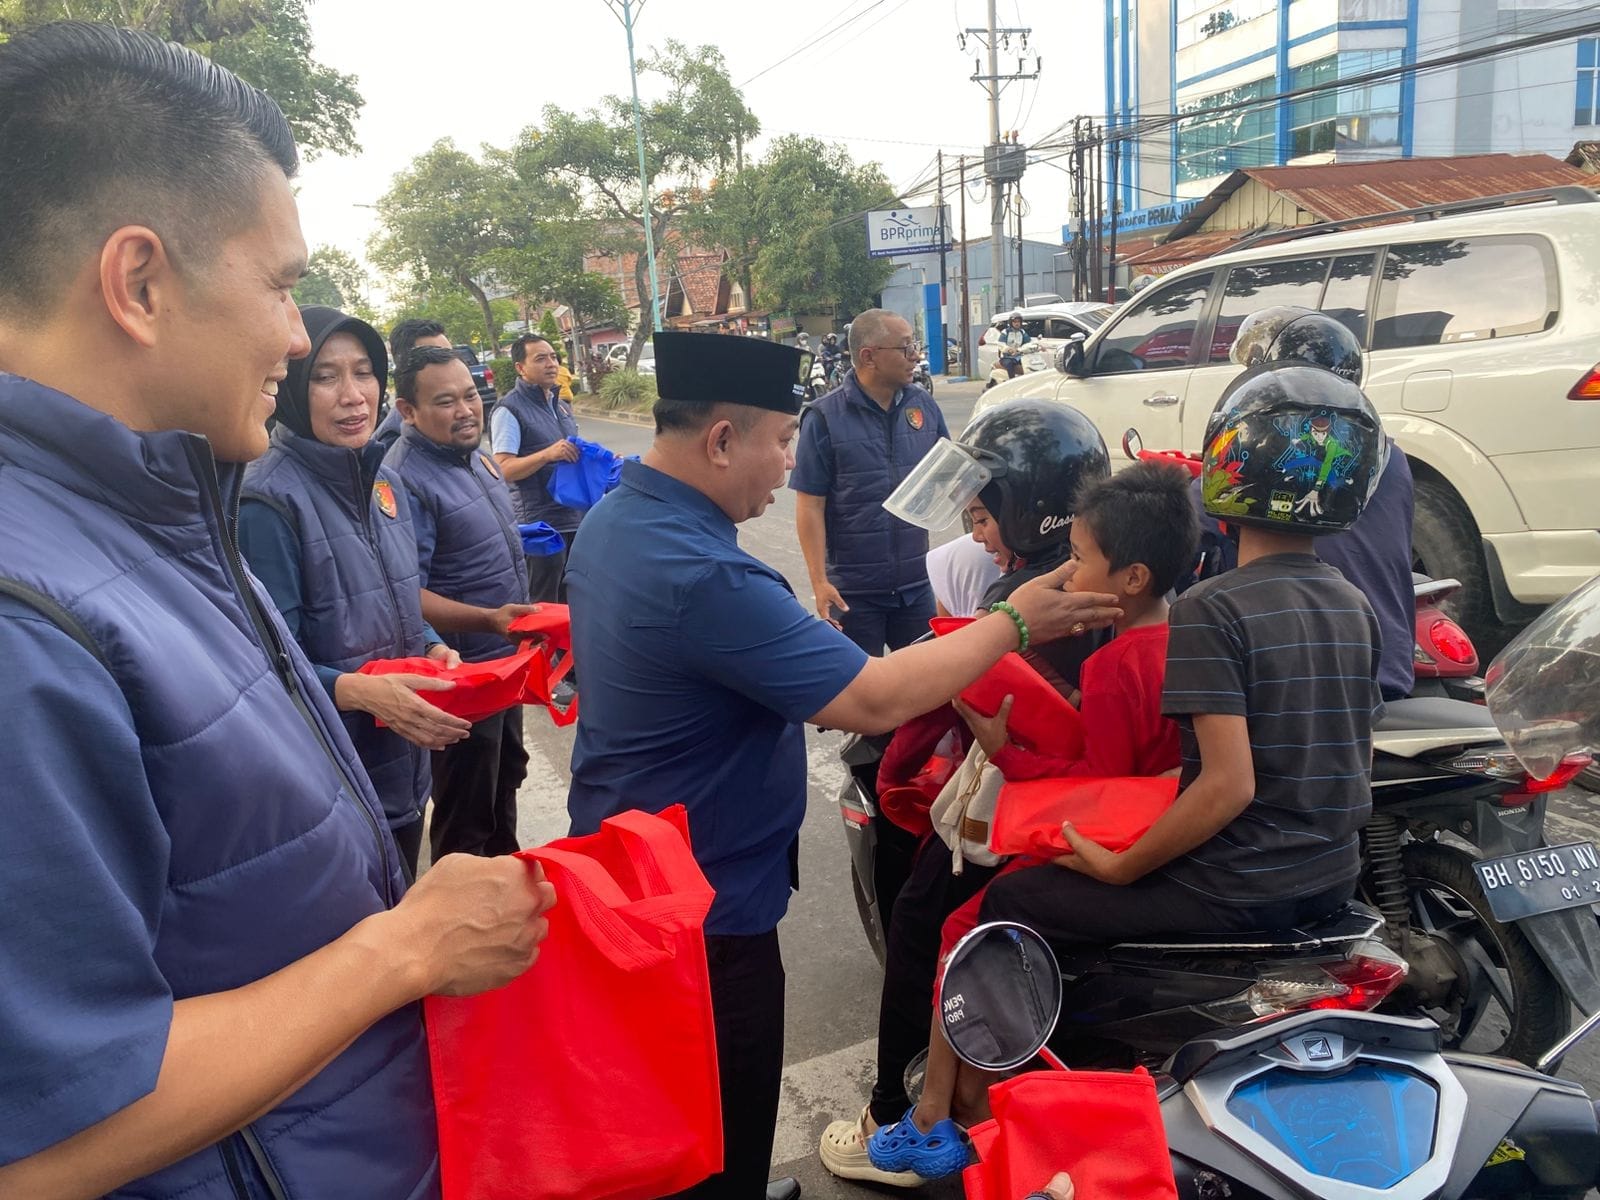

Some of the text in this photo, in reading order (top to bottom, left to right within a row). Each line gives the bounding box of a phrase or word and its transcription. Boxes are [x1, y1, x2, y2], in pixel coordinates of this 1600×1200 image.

[1147, 206, 1178, 226] PRIMA
[1498, 807, 1527, 817] HONDA
[1481, 846, 1599, 889] BH 6150 NV
